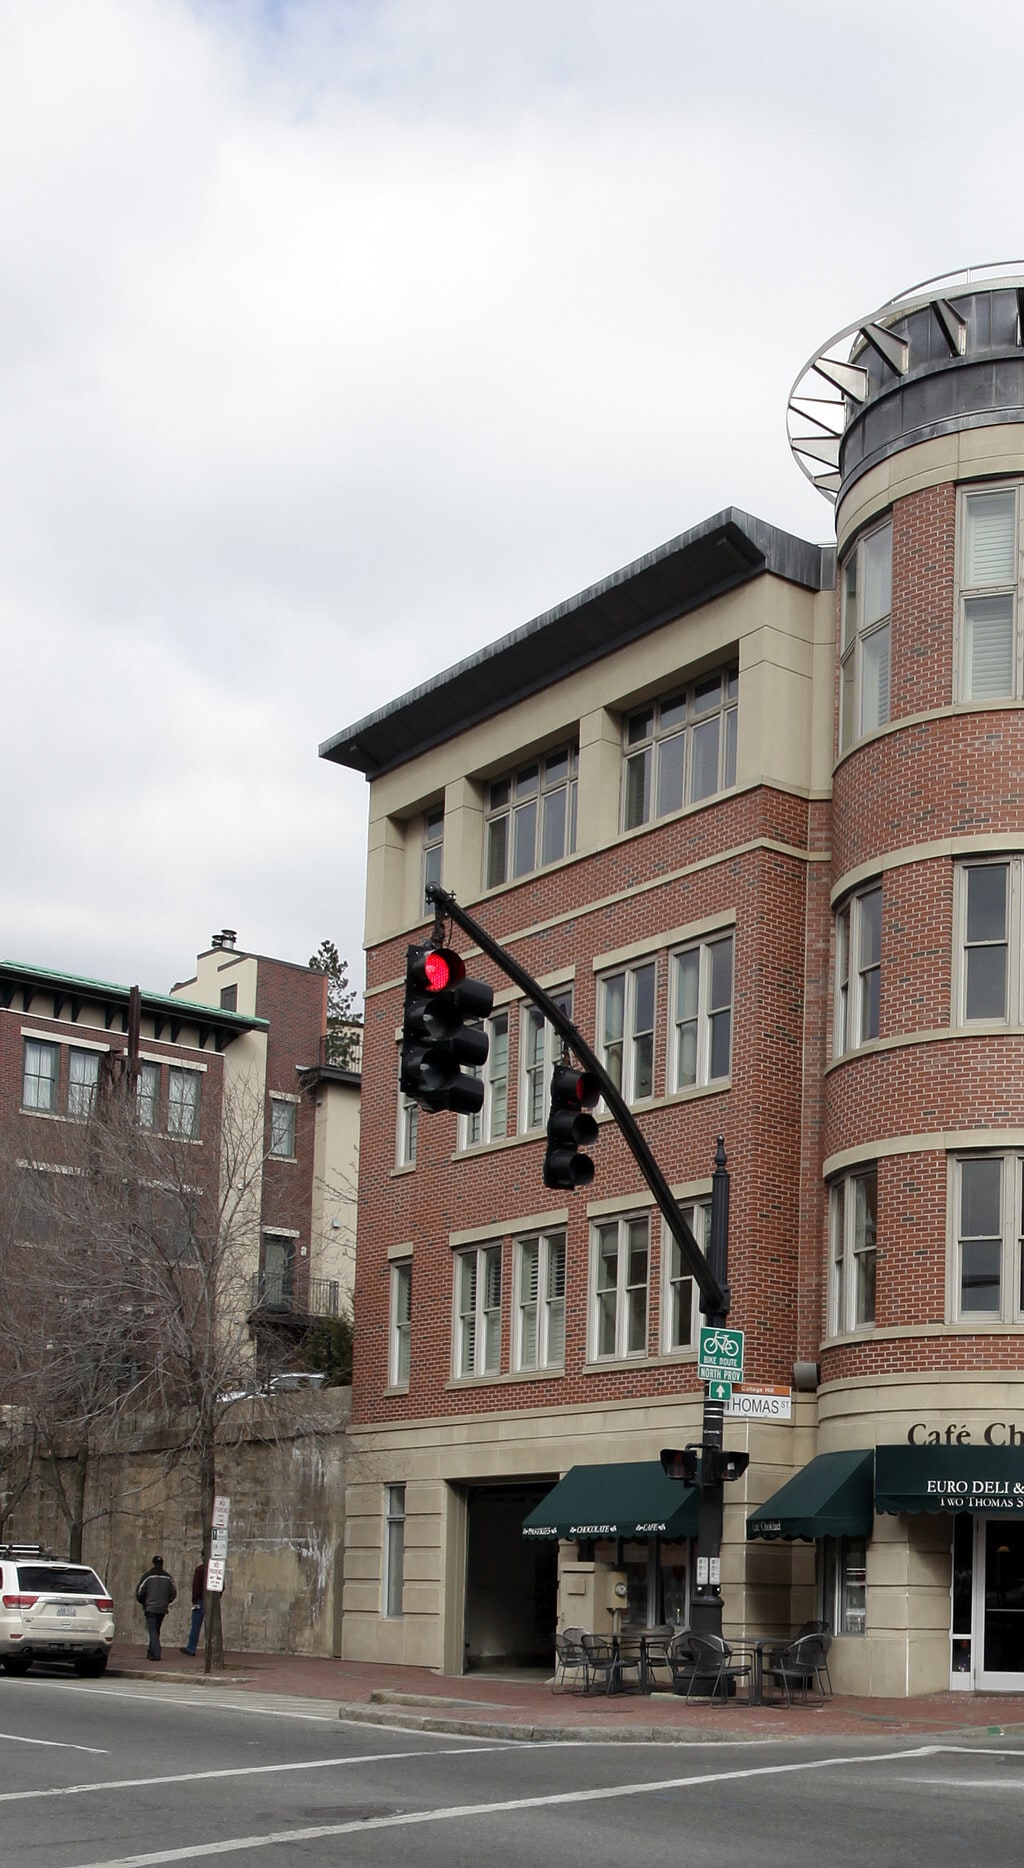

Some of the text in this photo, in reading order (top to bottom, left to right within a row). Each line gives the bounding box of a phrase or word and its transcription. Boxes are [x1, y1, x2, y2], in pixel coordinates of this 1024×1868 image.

[703, 1355, 738, 1367] BIKE ROUTE
[700, 1367, 741, 1381] NORTH PROV
[907, 1423, 971, 1446] Café
[927, 1480, 968, 1494] EURO
[972, 1480, 1009, 1494] DELI
[938, 1495, 964, 1507] TWO
[966, 1496, 1014, 1508] THOMAS
[576, 1524, 610, 1534] CHOCOLATE
[643, 1523, 658, 1532] CAFE
